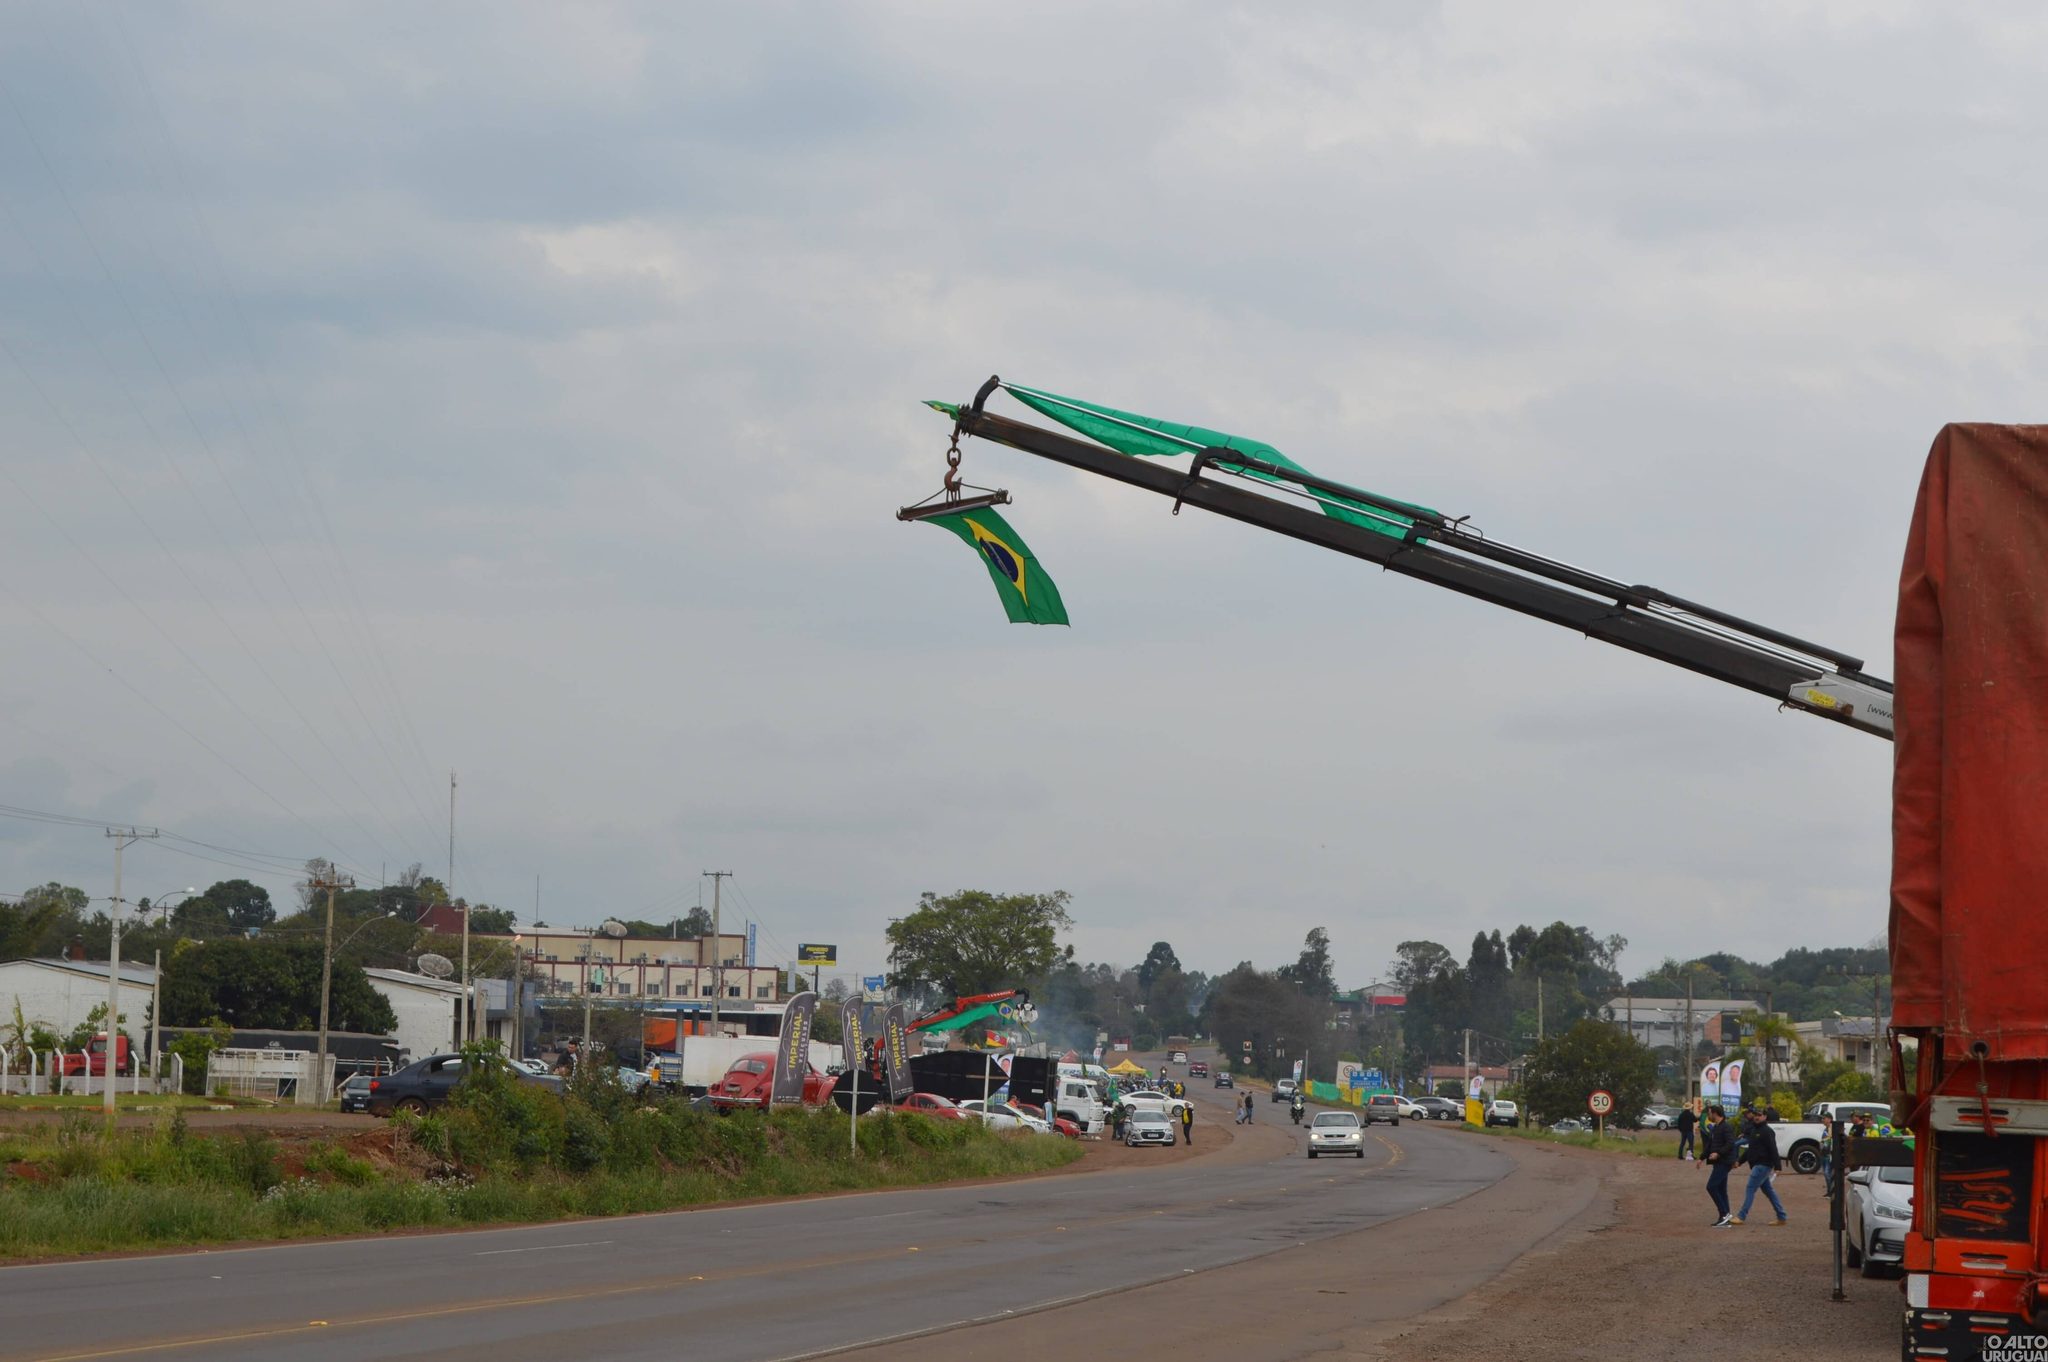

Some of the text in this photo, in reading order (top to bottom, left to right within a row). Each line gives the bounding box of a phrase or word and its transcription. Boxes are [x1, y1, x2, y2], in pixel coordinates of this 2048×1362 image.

[788, 1012, 803, 1070] IMPERIAL
[851, 1013, 862, 1064] IMPERIAL
[890, 1022, 902, 1070] IMPERIAL
[1593, 1096, 1609, 1107] 50
